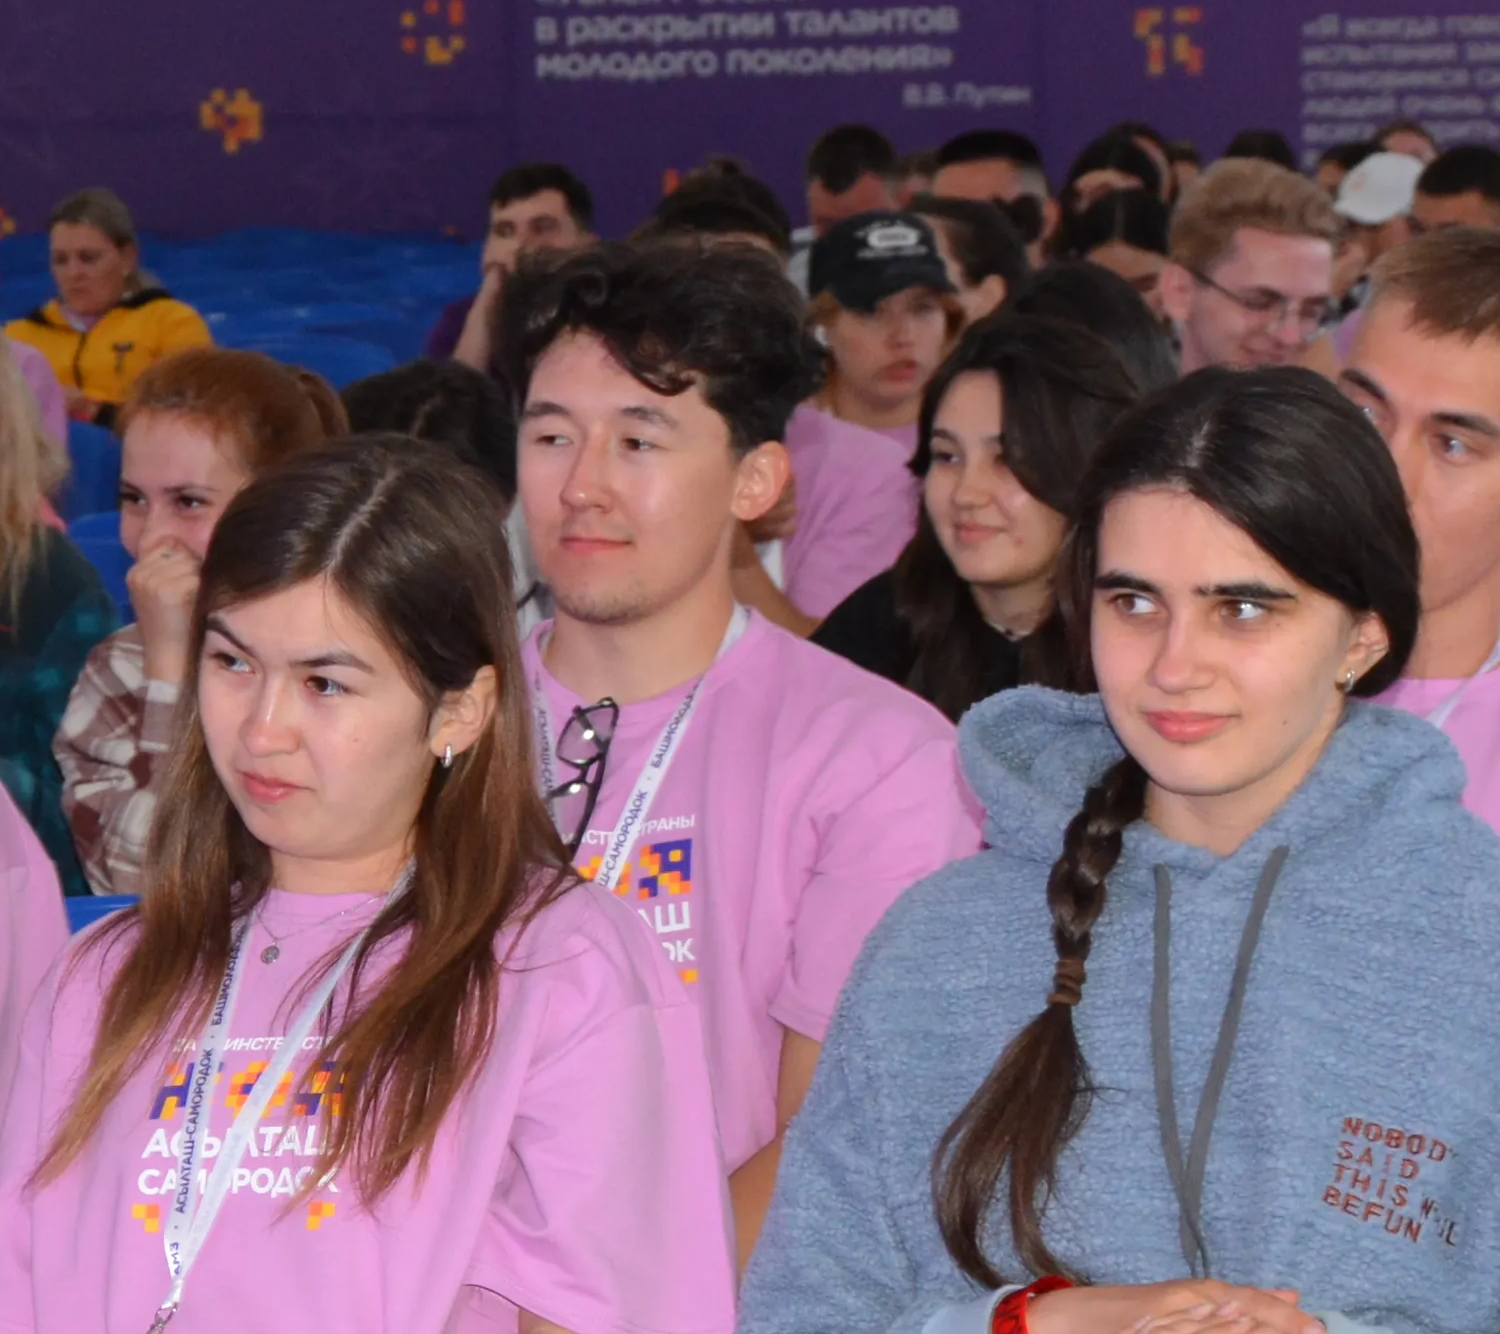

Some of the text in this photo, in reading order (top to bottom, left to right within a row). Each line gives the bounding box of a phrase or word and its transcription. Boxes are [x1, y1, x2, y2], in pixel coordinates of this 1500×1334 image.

[535, 5, 959, 46] в раскрытии талантов
[536, 44, 953, 82] молодого поколения»
[955, 82, 1032, 110] Путин
[174, 1048, 215, 1215] АСЫЛТАШ-САМОРОДОК
[1336, 1140, 1420, 1180] SAID
[1333, 1163, 1409, 1208] THIS
